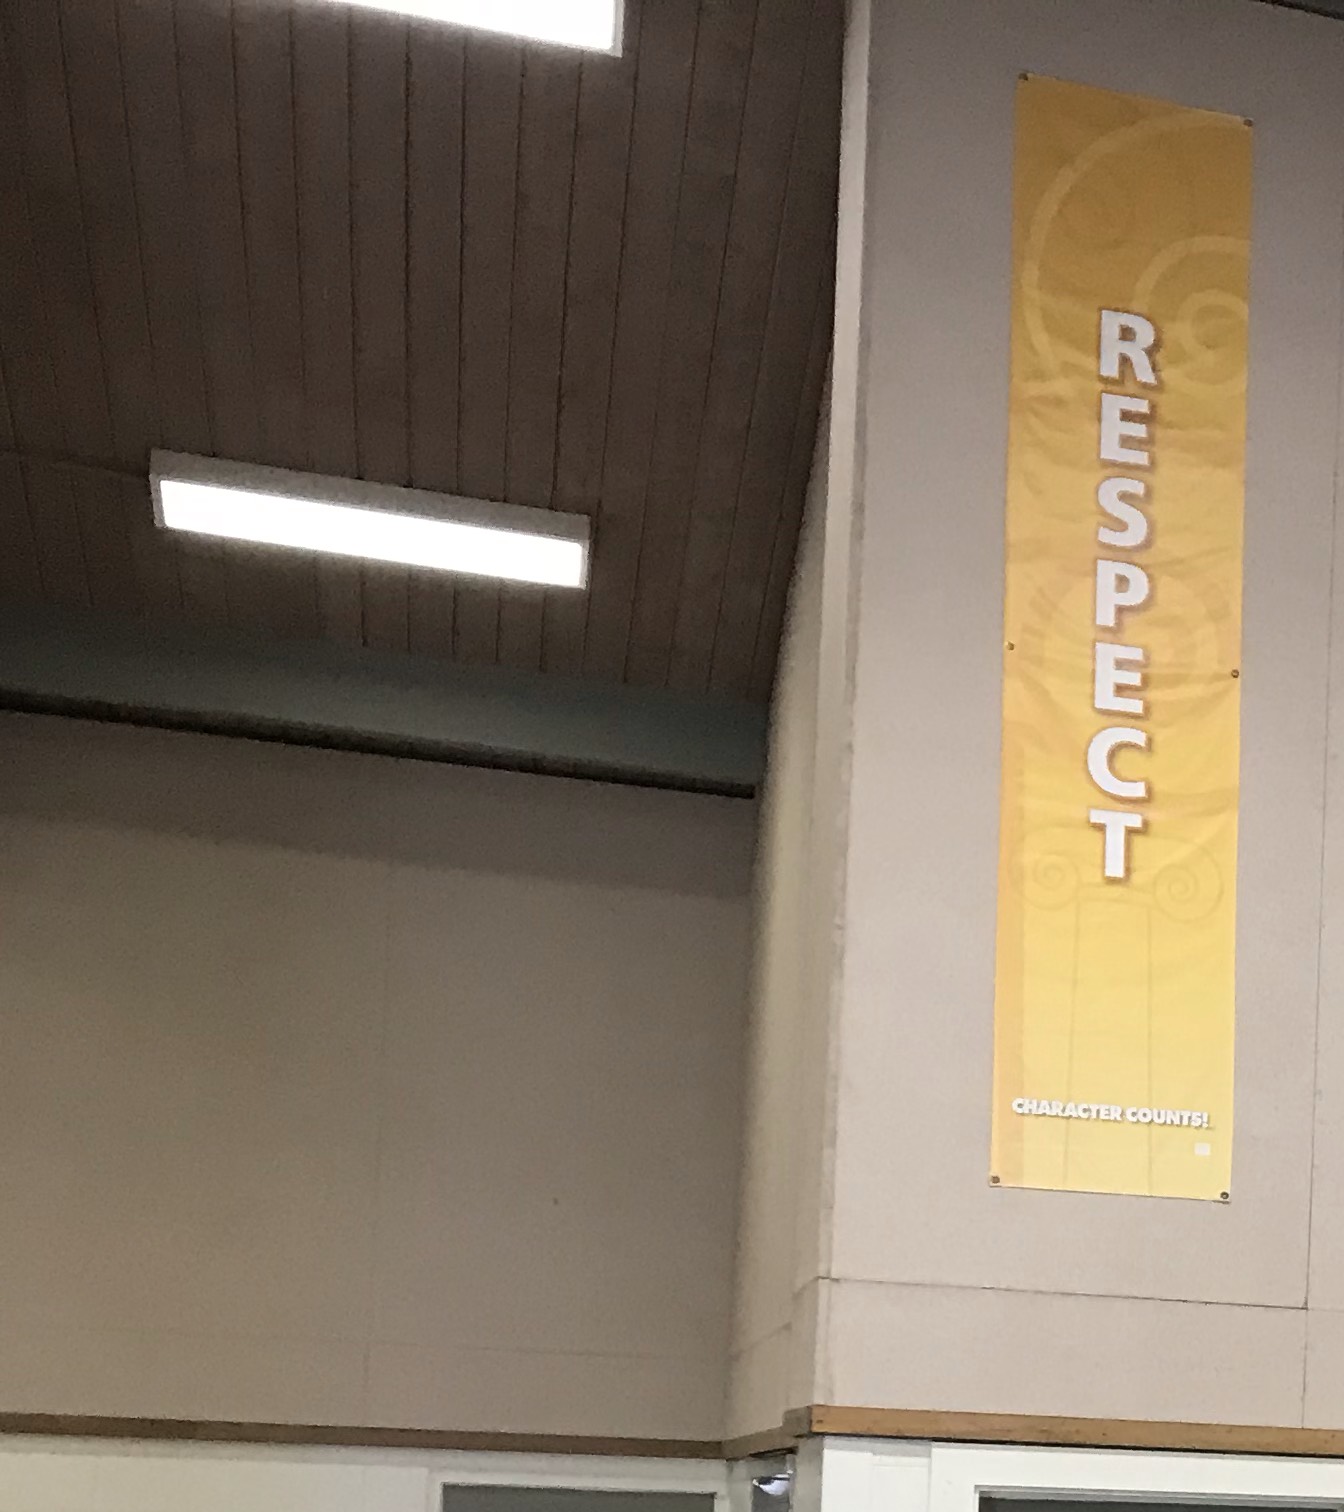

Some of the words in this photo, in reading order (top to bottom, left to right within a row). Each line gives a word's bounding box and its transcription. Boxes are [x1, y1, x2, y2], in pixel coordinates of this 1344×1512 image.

[1086, 307, 1160, 879] RESPECT
[1012, 1097, 1122, 1122] CHARACTER
[1126, 1107, 1209, 1128] COUNTS!
